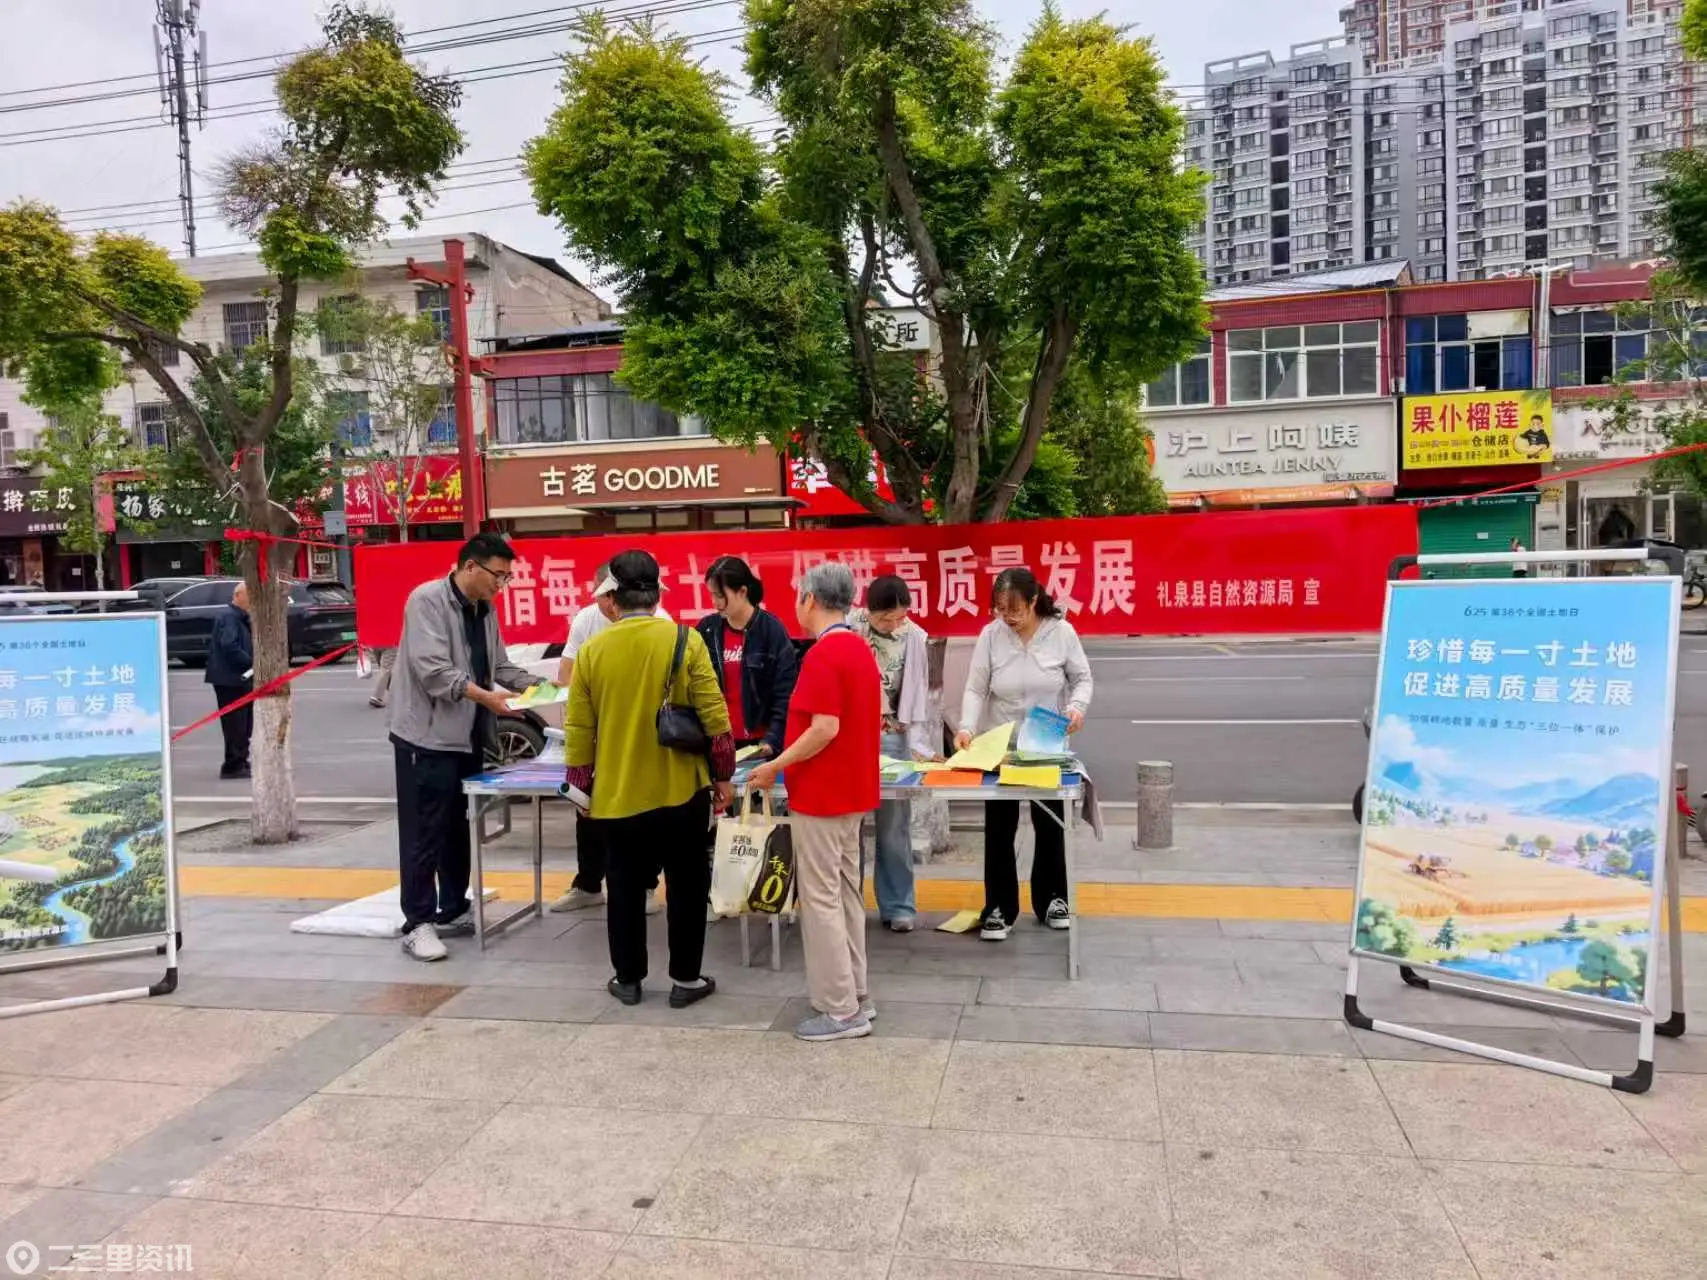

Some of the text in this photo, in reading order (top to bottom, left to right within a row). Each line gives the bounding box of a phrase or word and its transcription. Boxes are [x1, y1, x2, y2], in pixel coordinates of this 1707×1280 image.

[1411, 400, 1520, 434] 果仆榴莲
[1471, 434, 1509, 447] 仓储店
[540, 463, 720, 496] 古茗 GOODME
[1184, 455, 1342, 478] AUNTEA JENNY
[1156, 577, 1320, 609] 礼泉县自然资源局 宣
[1464, 605, 1488, 617] 625
[1406, 637, 1637, 669] 珍惜每一寸土地
[1403, 671, 1634, 707] 促进高质量发展
